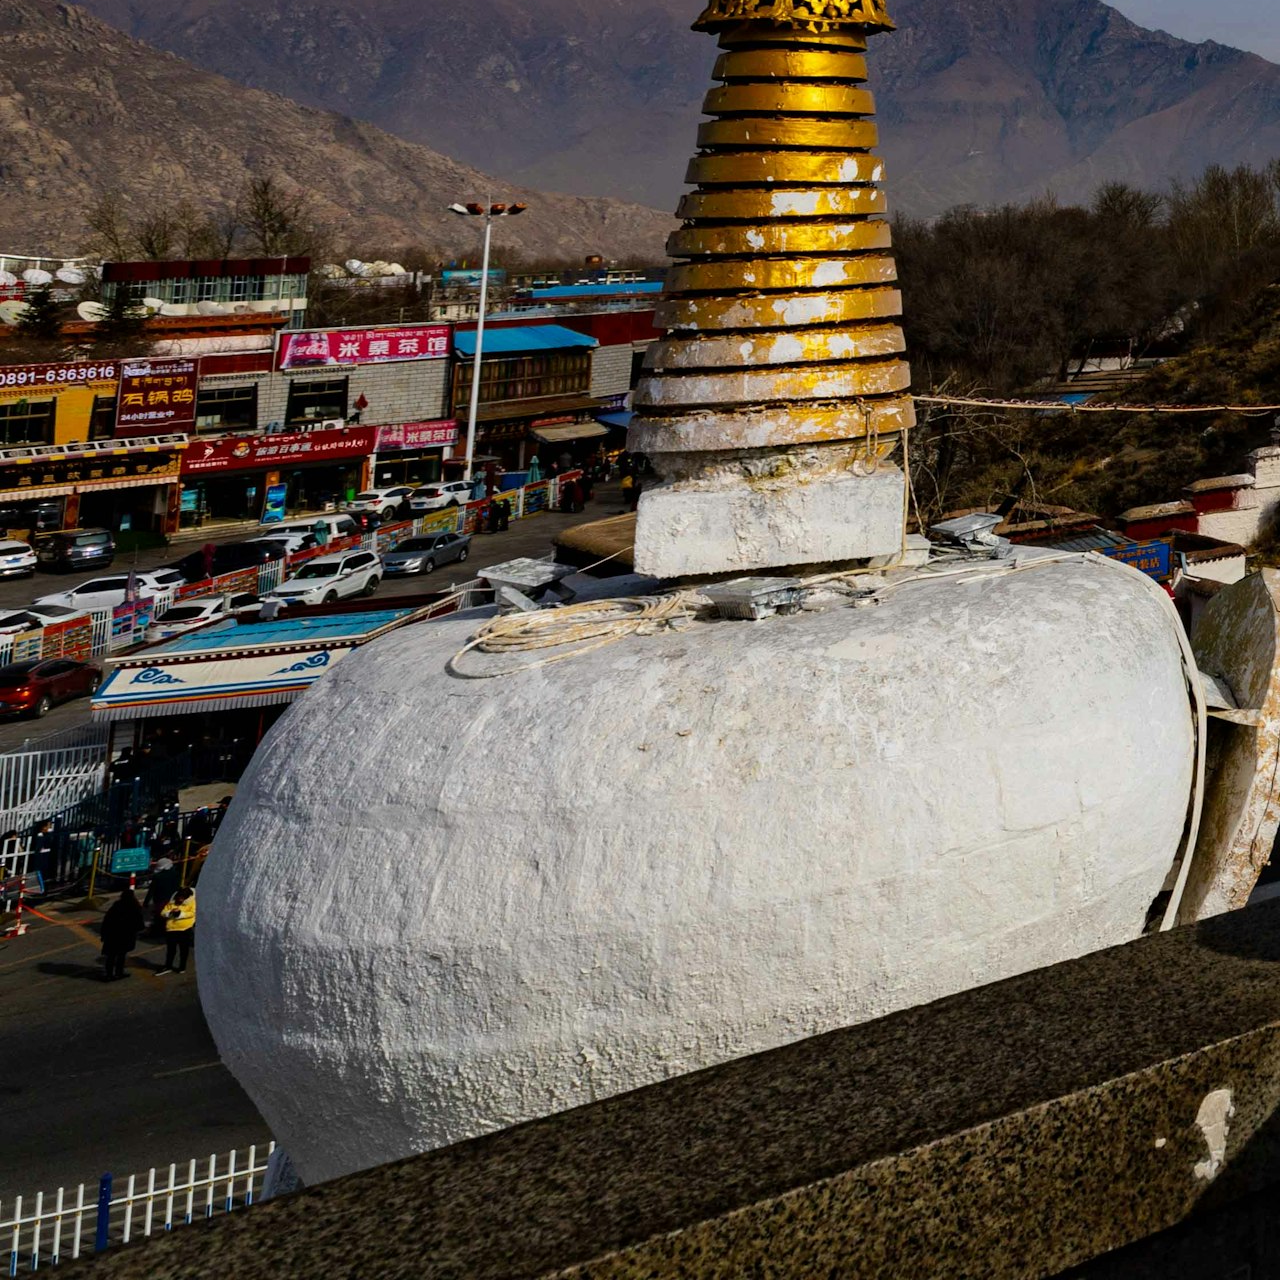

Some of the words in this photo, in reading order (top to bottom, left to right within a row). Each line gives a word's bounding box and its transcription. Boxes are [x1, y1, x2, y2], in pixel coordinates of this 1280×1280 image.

[338, 336, 448, 358] 米桑茶馆
[121, 388, 194, 407] 石锅鸡
